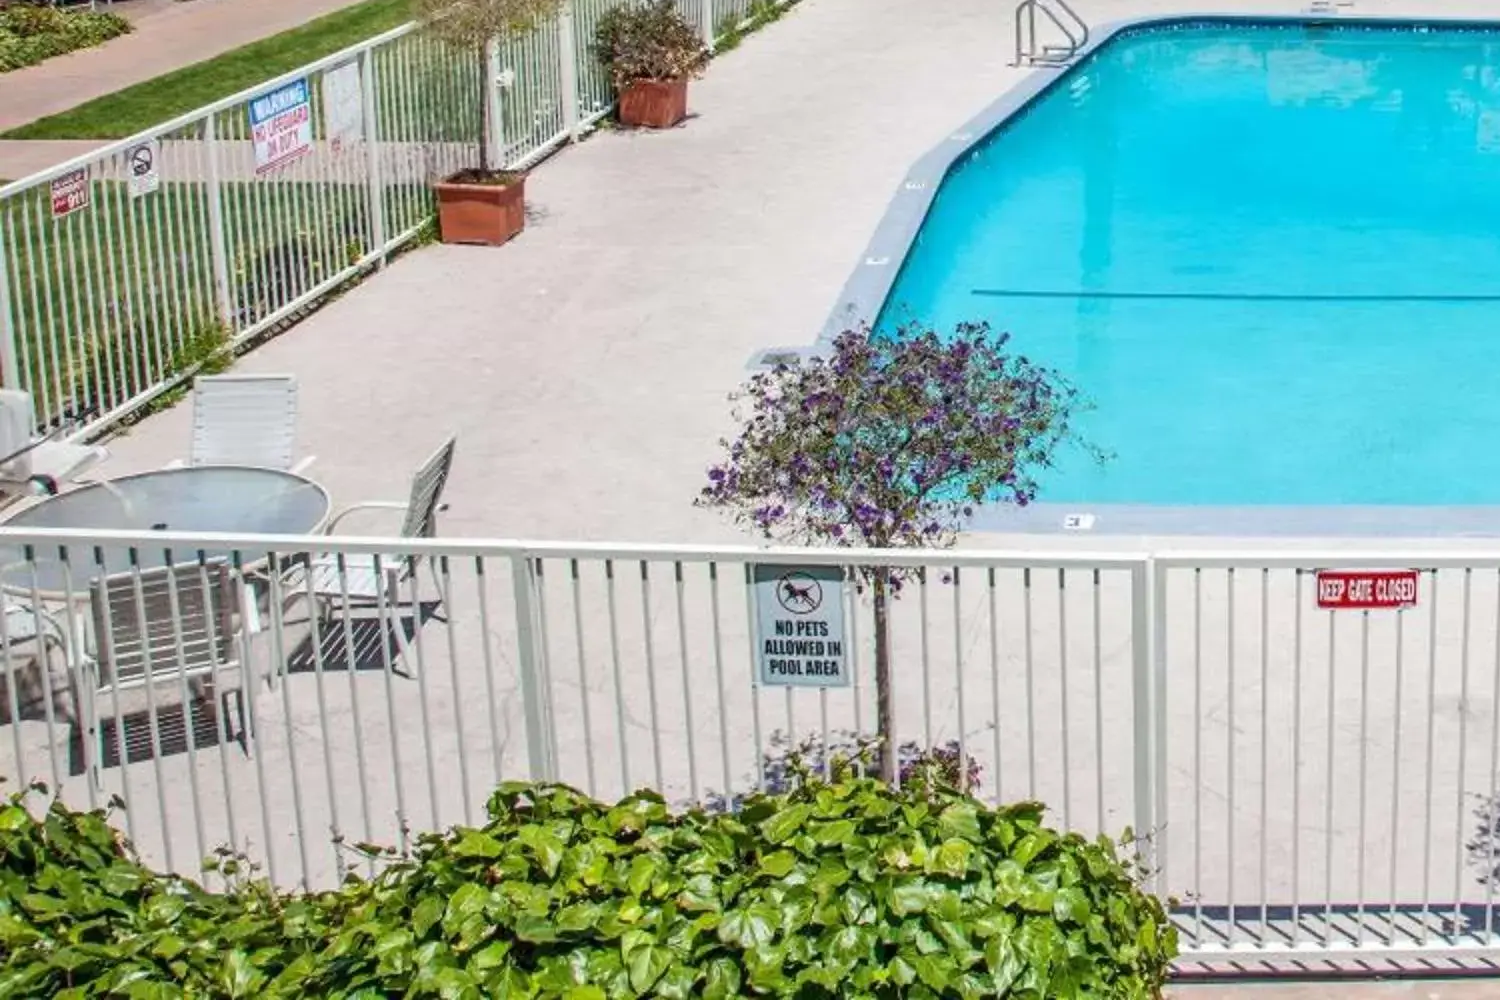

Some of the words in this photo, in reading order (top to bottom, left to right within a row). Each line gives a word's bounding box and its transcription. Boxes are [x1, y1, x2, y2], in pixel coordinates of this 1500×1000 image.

[253, 82, 305, 121] WARNING
[1319, 578, 1346, 602] KEEP
[1347, 578, 1373, 602] GATE
[1375, 577, 1415, 602] CLOSED
[775, 619, 793, 636] NO
[797, 621, 829, 637] PETS
[765, 639, 825, 656] ALLOWED
[827, 641, 842, 657] IN
[769, 659, 804, 675] POOL
[805, 660, 840, 677] AREA
